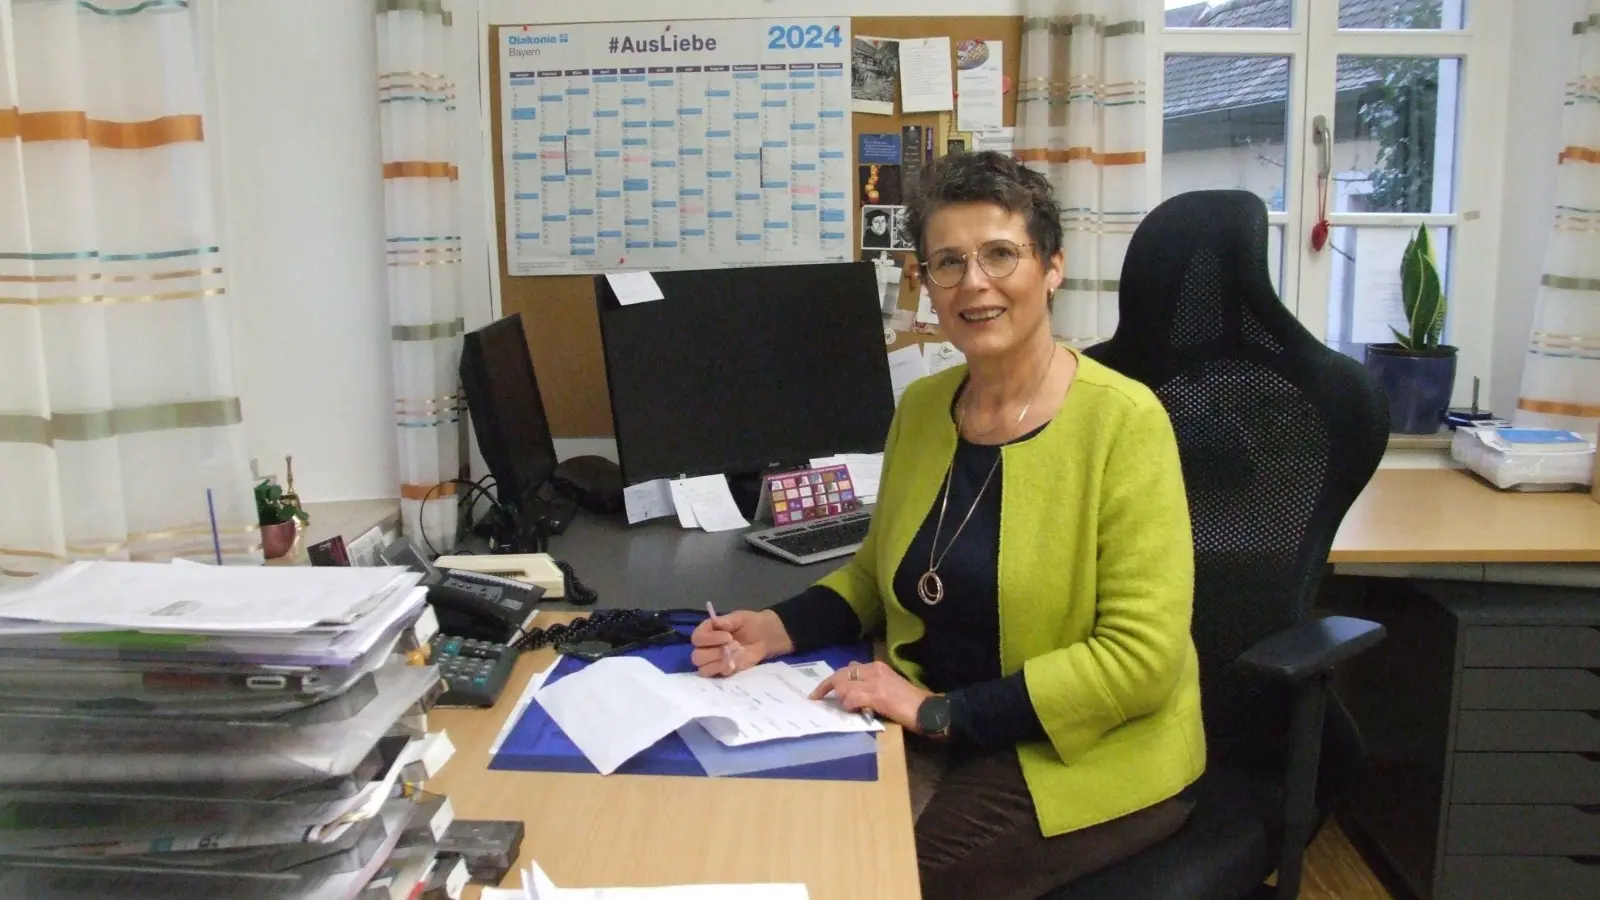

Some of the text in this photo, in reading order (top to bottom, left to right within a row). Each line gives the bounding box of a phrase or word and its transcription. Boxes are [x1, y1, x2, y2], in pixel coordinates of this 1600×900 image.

[508, 35, 557, 45] Diakonie
[608, 34, 717, 54] #AusLiebe
[767, 24, 843, 49] 2024
[508, 47, 541, 58] Bayern
